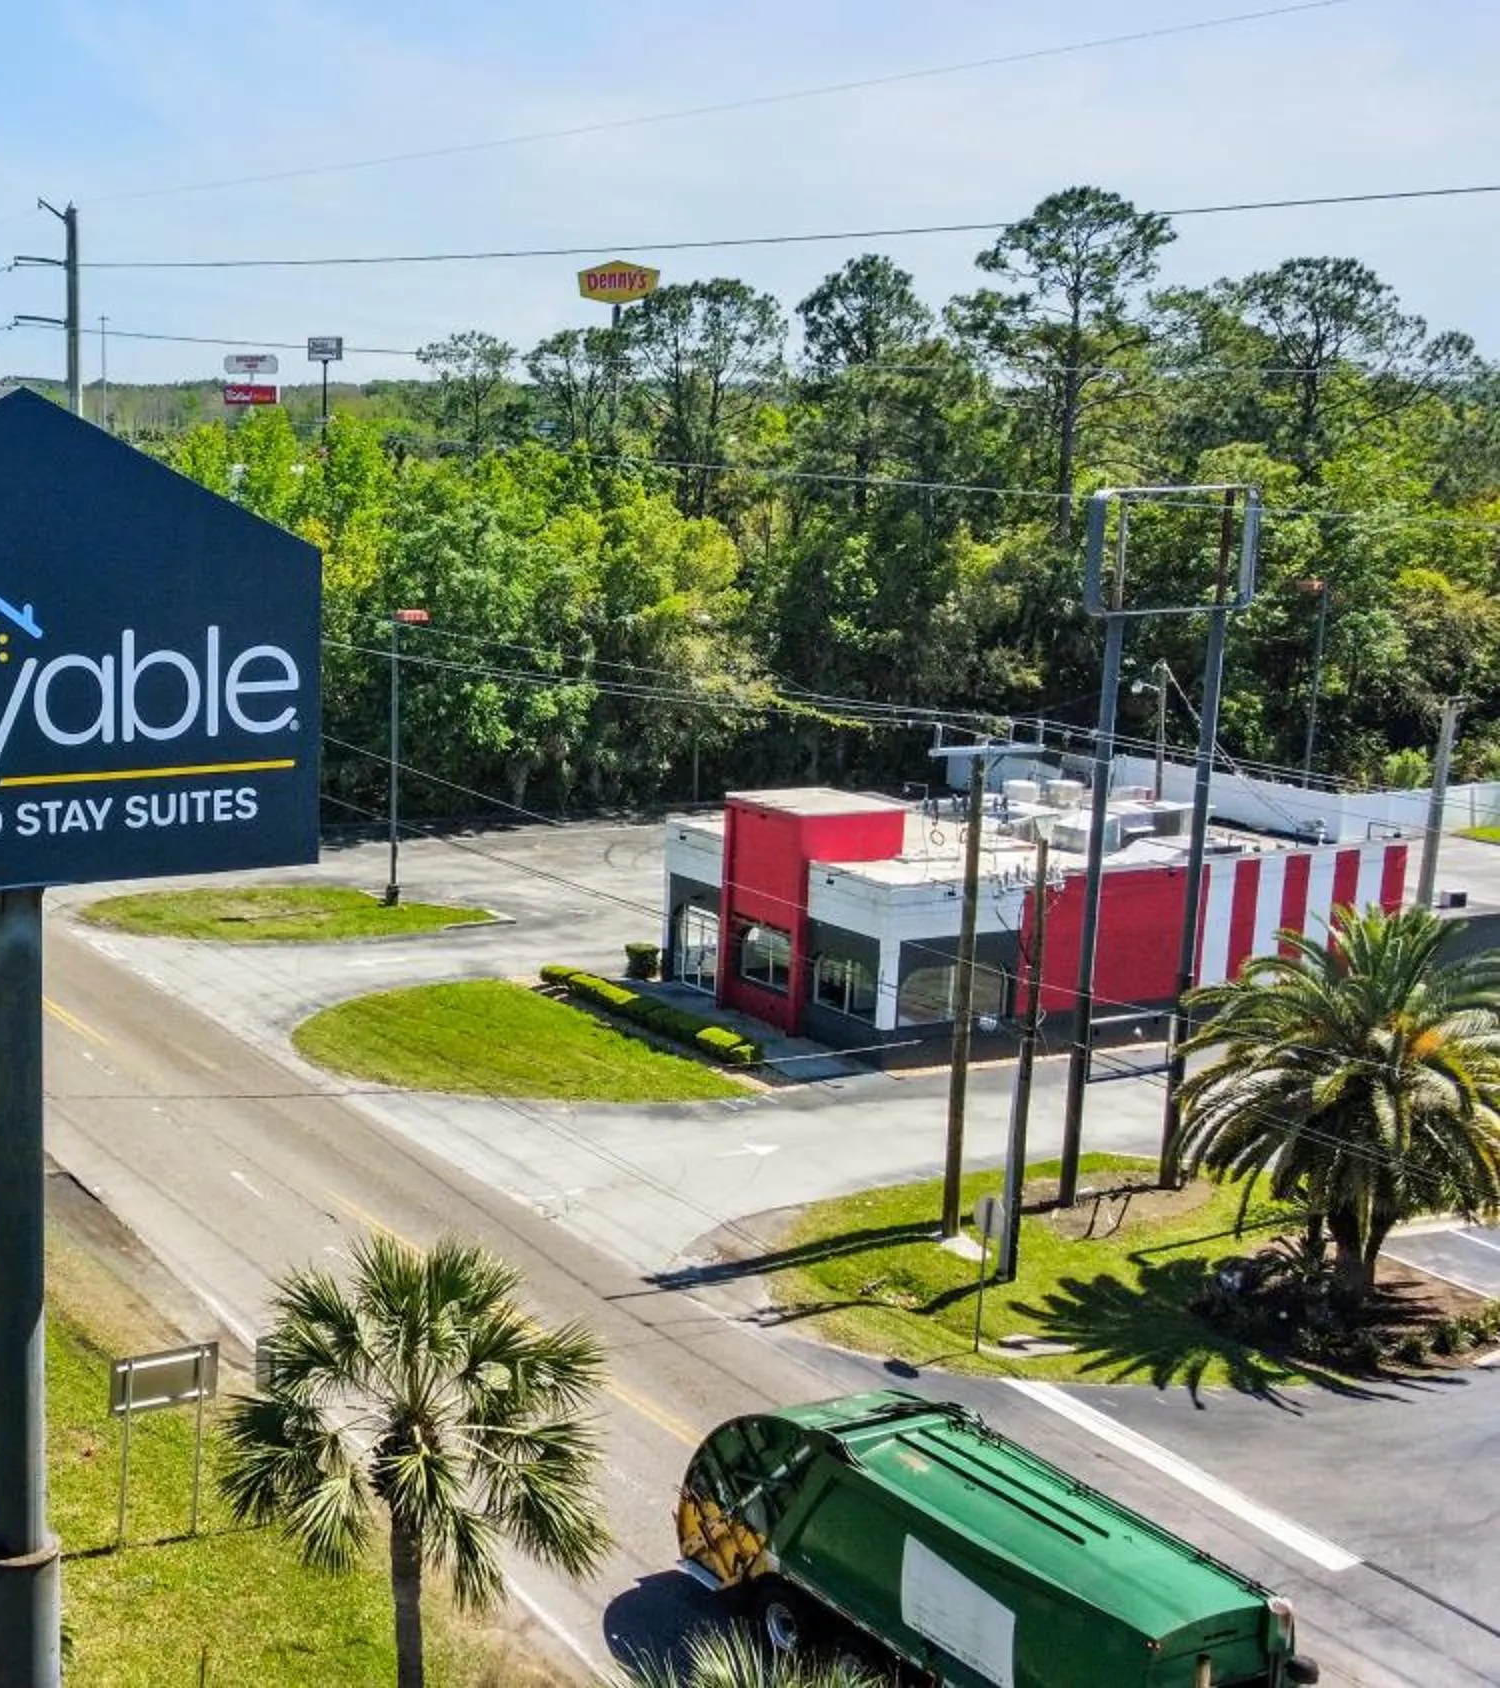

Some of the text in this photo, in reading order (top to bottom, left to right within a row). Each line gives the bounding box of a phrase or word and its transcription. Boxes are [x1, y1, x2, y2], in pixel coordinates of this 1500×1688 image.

[587, 271, 648, 290] Denny's
[16, 797, 114, 837] STAY
[125, 787, 259, 829] SUITES
